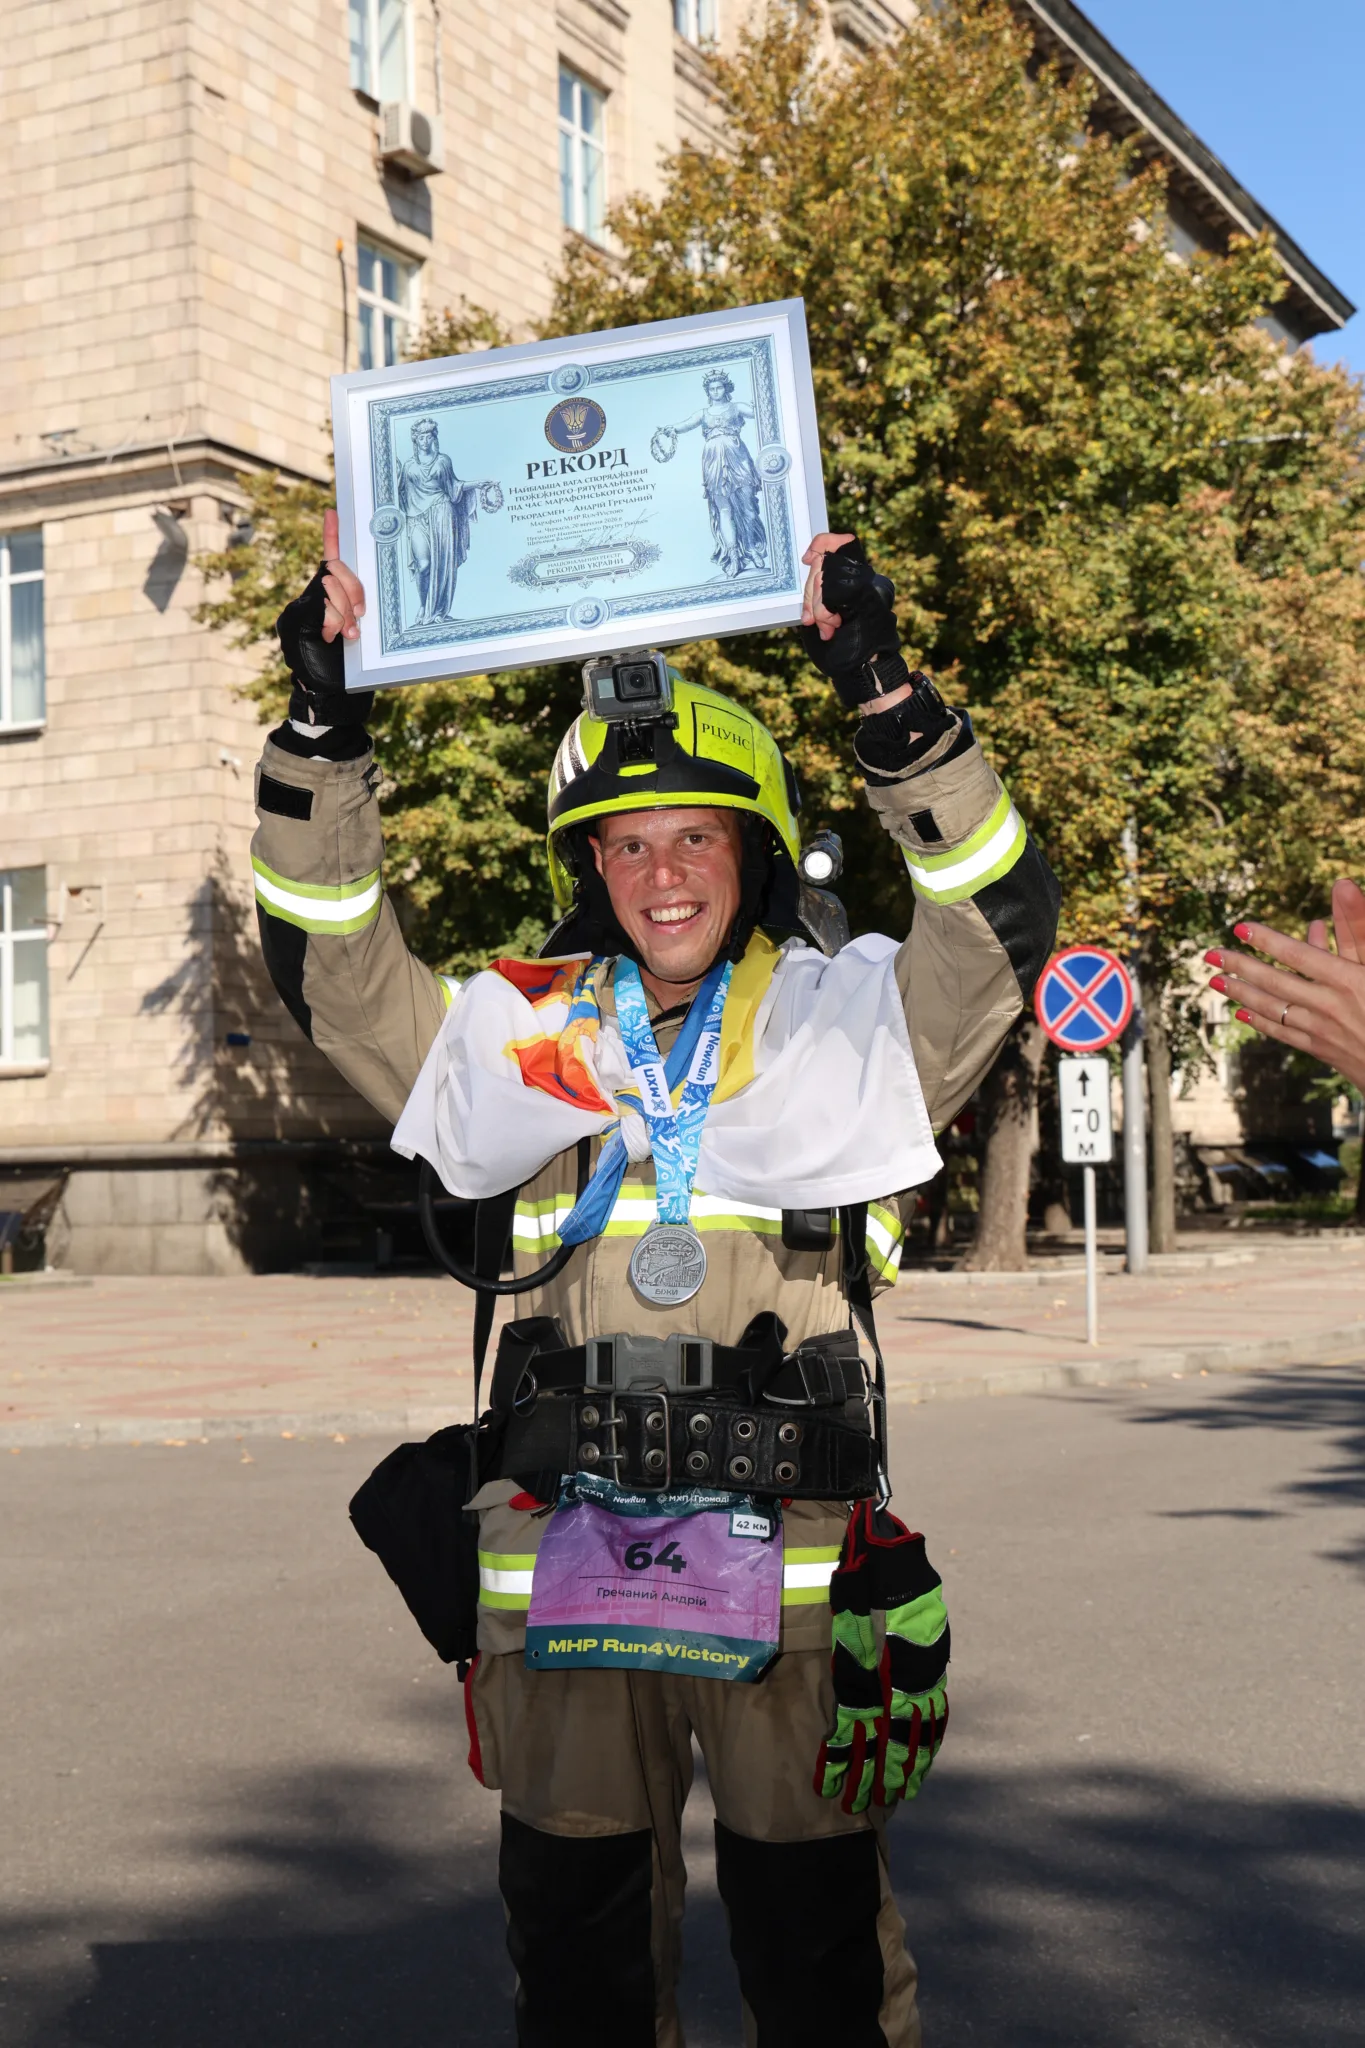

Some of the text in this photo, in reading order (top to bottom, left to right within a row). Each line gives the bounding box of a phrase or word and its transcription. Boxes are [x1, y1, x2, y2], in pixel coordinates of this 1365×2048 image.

[526, 448, 629, 480] РЕКОРД
[546, 557, 624, 576] РЕКОРДІВ УКРАЇНИ
[701, 723, 751, 751] РЦУНС
[696, 1034, 721, 1081] NewRun
[643, 1068, 661, 1098] МХП
[581, 1487, 604, 1499] МХП
[613, 1496, 646, 1504] NewRun
[669, 1495, 689, 1503] МХП
[694, 1495, 730, 1504] Громаді
[736, 1521, 750, 1530] 42
[624, 1541, 687, 1574] 64
[596, 1588, 707, 1607] Гречаний Андрій
[548, 1638, 750, 1669] MHP Run4Victory
